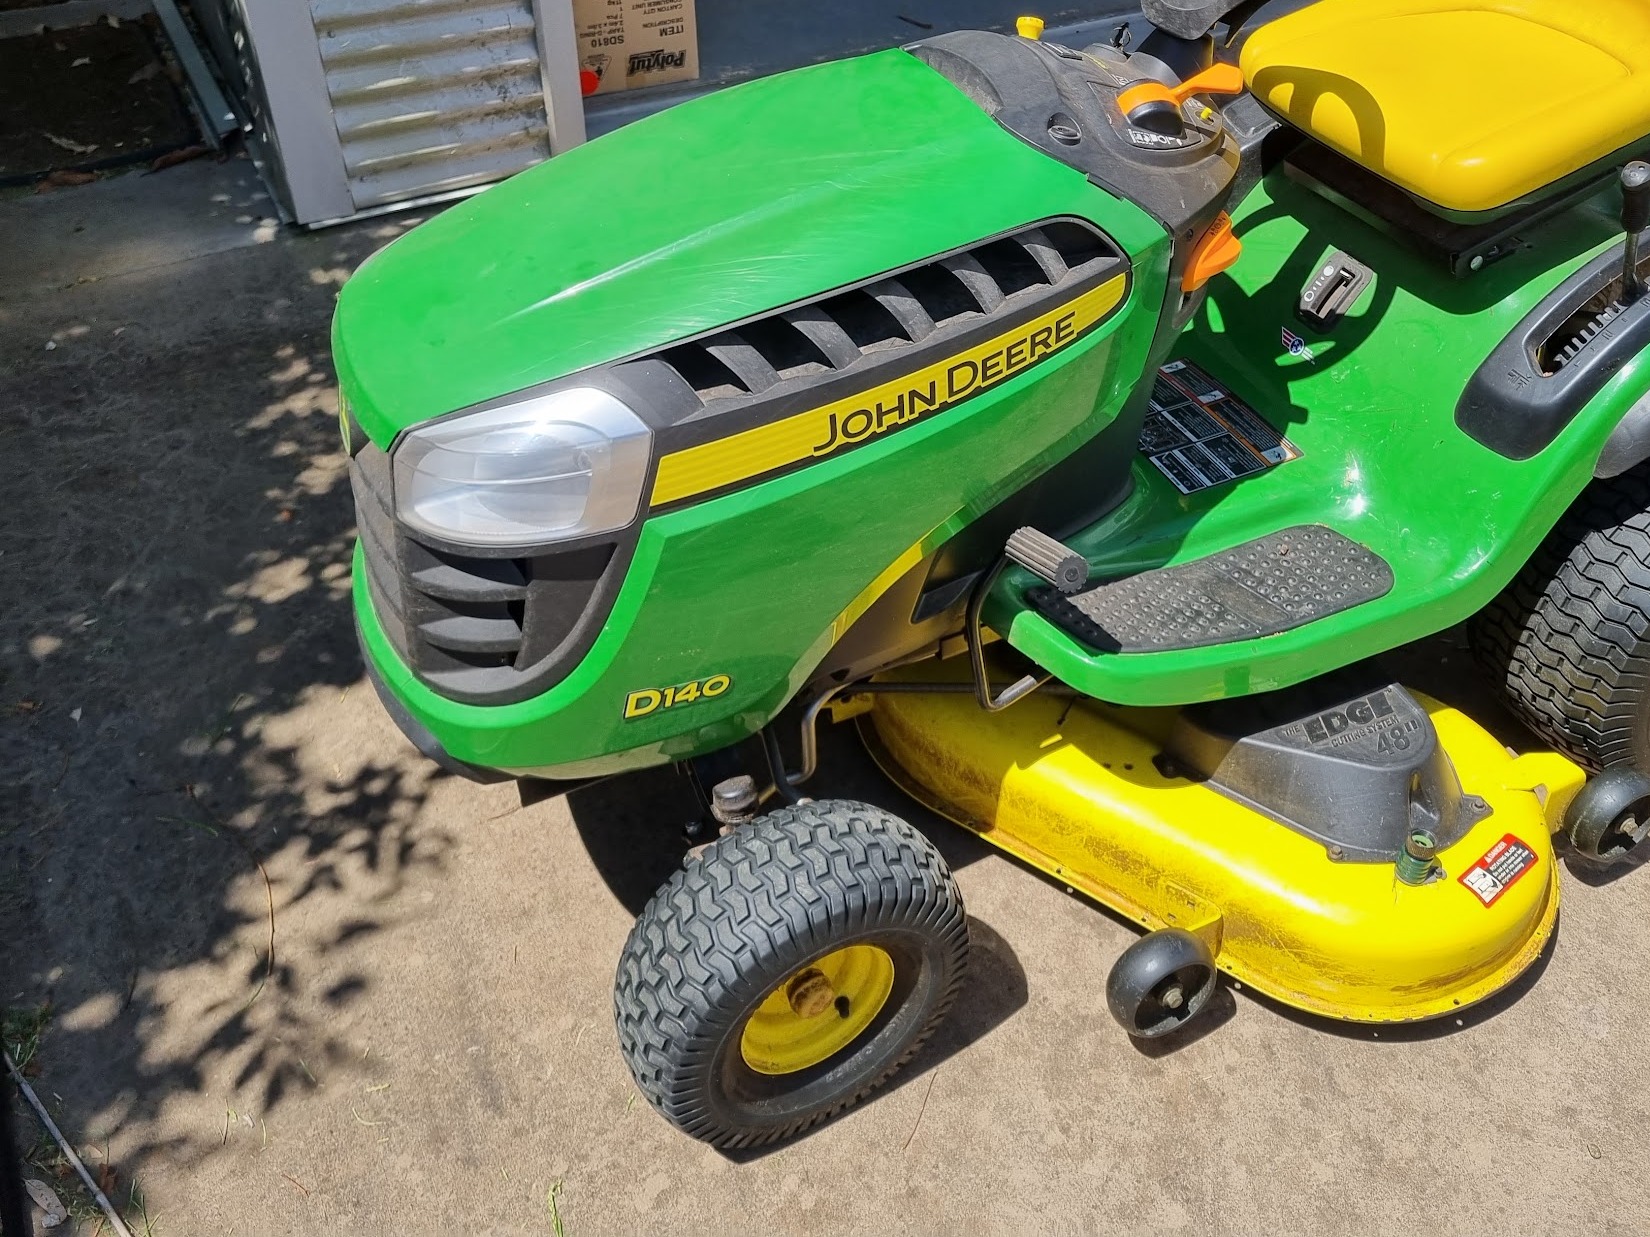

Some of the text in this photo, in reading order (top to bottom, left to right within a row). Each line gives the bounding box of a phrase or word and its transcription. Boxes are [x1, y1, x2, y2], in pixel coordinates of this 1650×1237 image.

[657, 4, 683, 12] CARTON
[642, 17, 684, 29] DESCRIPTION
[659, 25, 684, 37] ITEM
[591, 35, 624, 48] SD810
[813, 380, 936, 454] JOHN
[947, 311, 1075, 400] DEERE
[624, 675, 731, 719] D140
[1284, 724, 1300, 737] THE
[1302, 691, 1395, 744] EDGE
[1331, 715, 1399, 748] CUTTING SYSTEM
